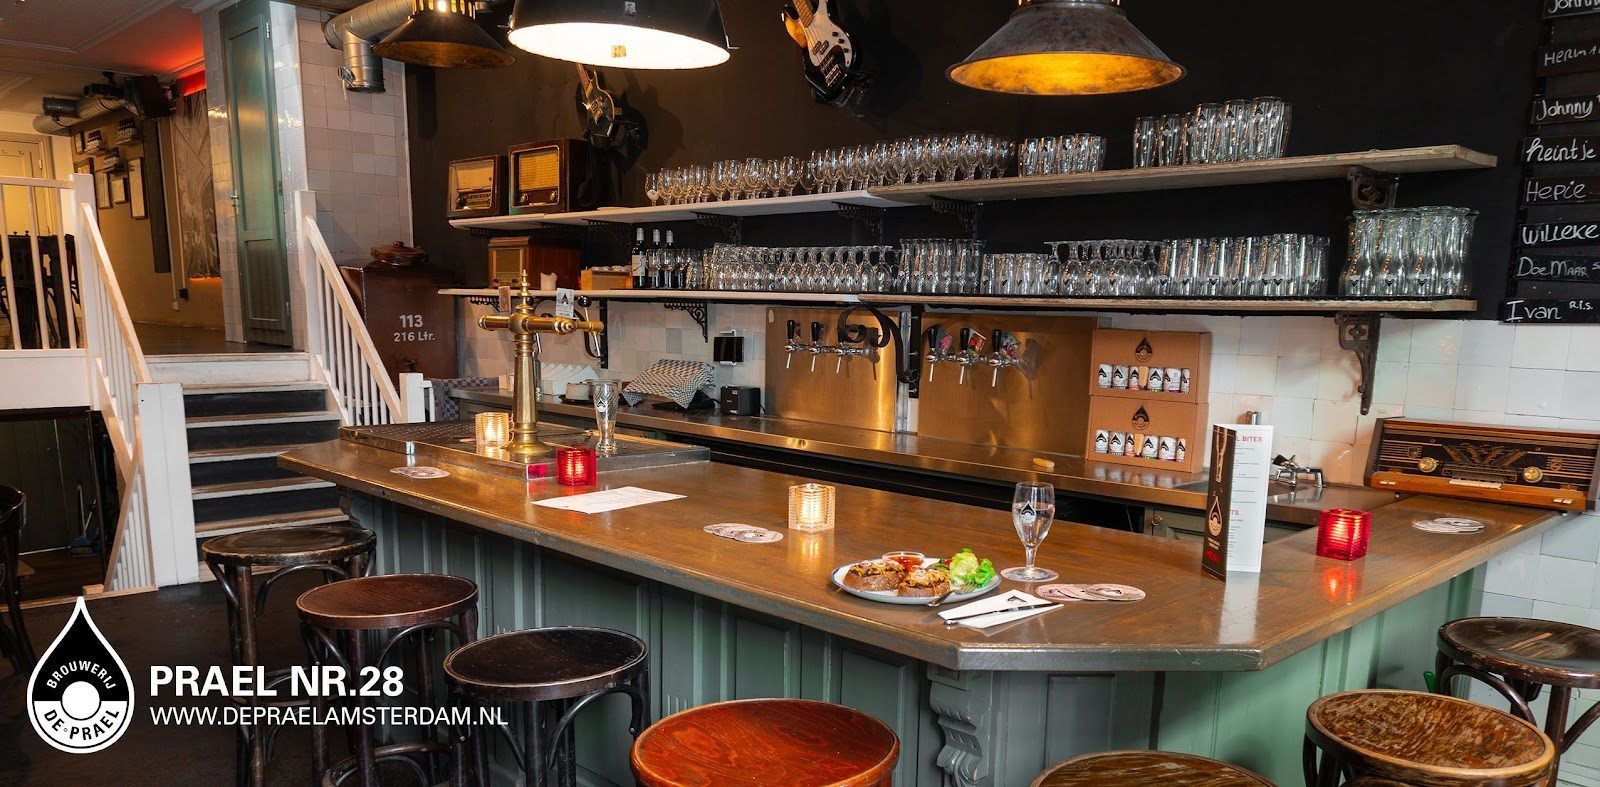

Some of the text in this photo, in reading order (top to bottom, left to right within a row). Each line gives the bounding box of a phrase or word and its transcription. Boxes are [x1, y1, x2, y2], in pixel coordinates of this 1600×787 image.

[1536, 99, 1593, 121] Johnny
[1505, 300, 1563, 321] Ivan
[399, 314, 424, 328] 113
[393, 330, 436, 342] 216 Ltr.
